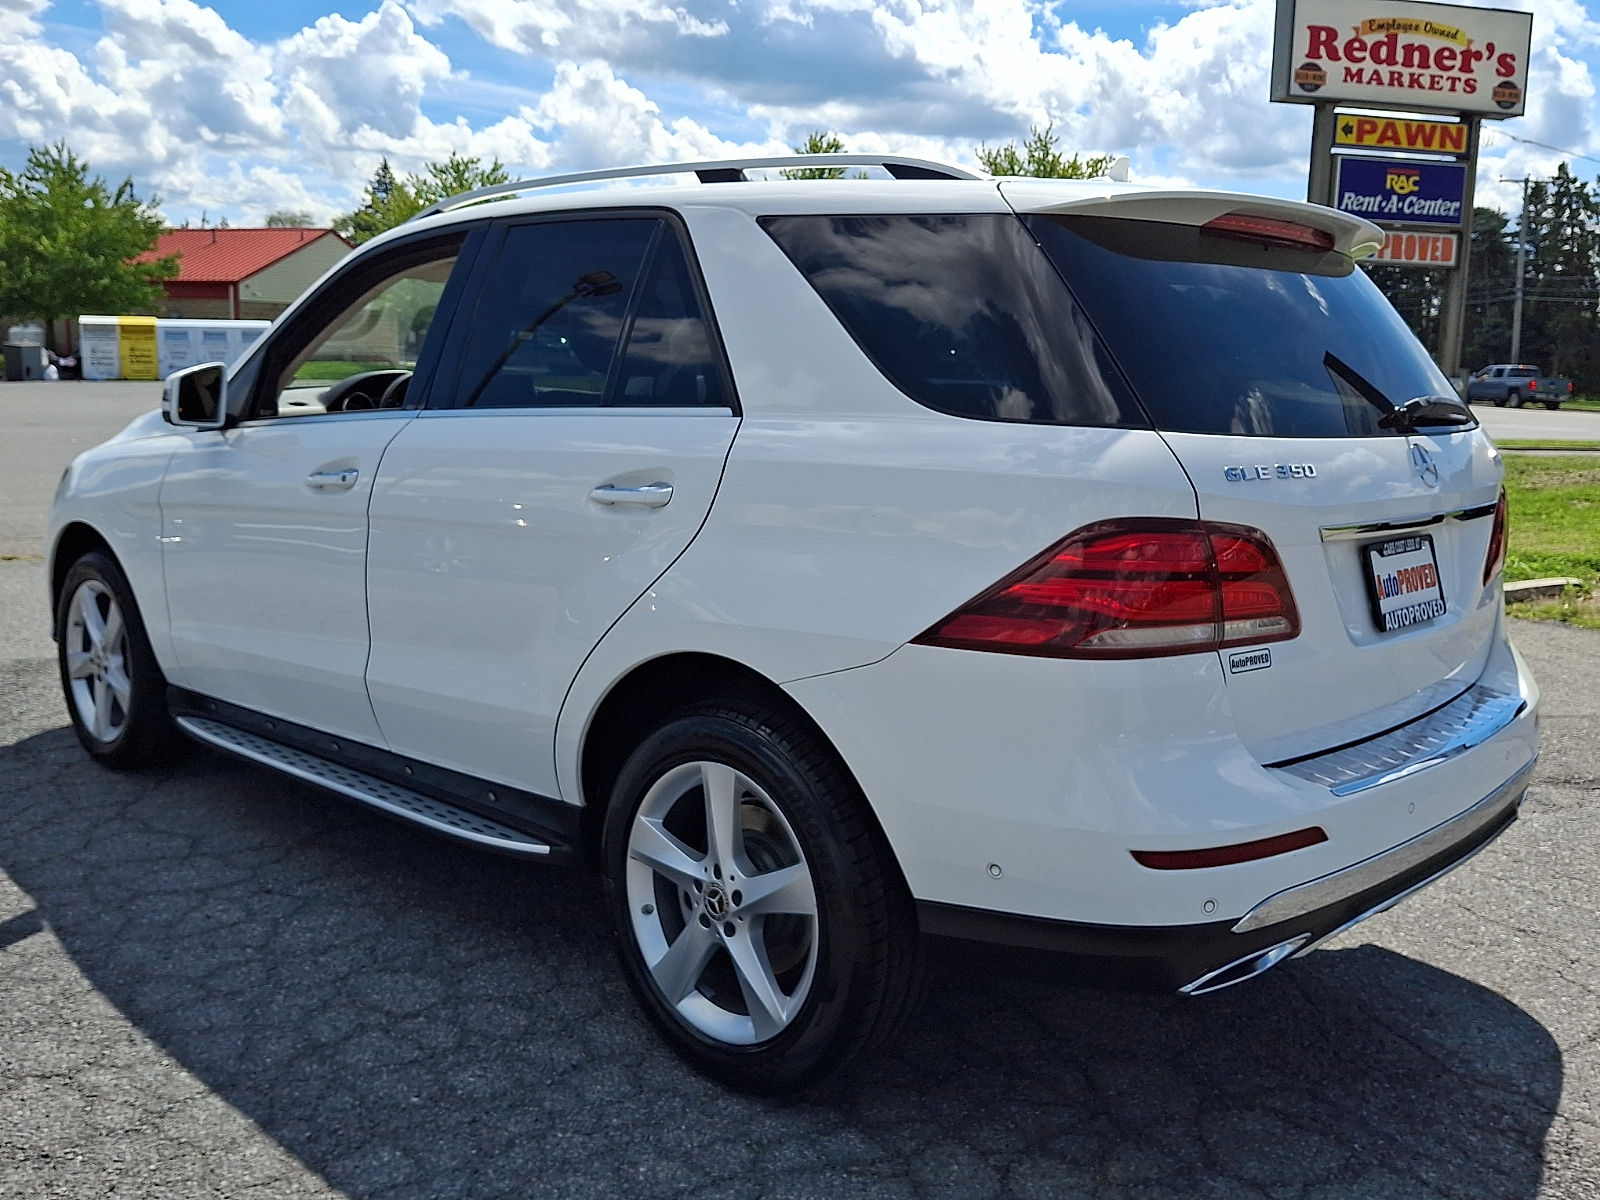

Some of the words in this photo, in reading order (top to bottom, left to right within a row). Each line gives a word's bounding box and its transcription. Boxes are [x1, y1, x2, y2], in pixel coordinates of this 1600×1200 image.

[1369, 19, 1420, 33] Employee
[1424, 21, 1459, 40] Owned
[1305, 25, 1516, 78] Redner's
[1342, 66, 1478, 94] MARKETS
[1355, 118, 1465, 151] PAWN
[1386, 174, 1420, 194] RAC
[1224, 464, 1272, 481] GLE
[1274, 463, 1317, 479] 350
[1376, 562, 1437, 600] AutoPROVED
[1385, 599, 1445, 631] AUTOPROVED
[1231, 653, 1270, 669] AutoPROVED
